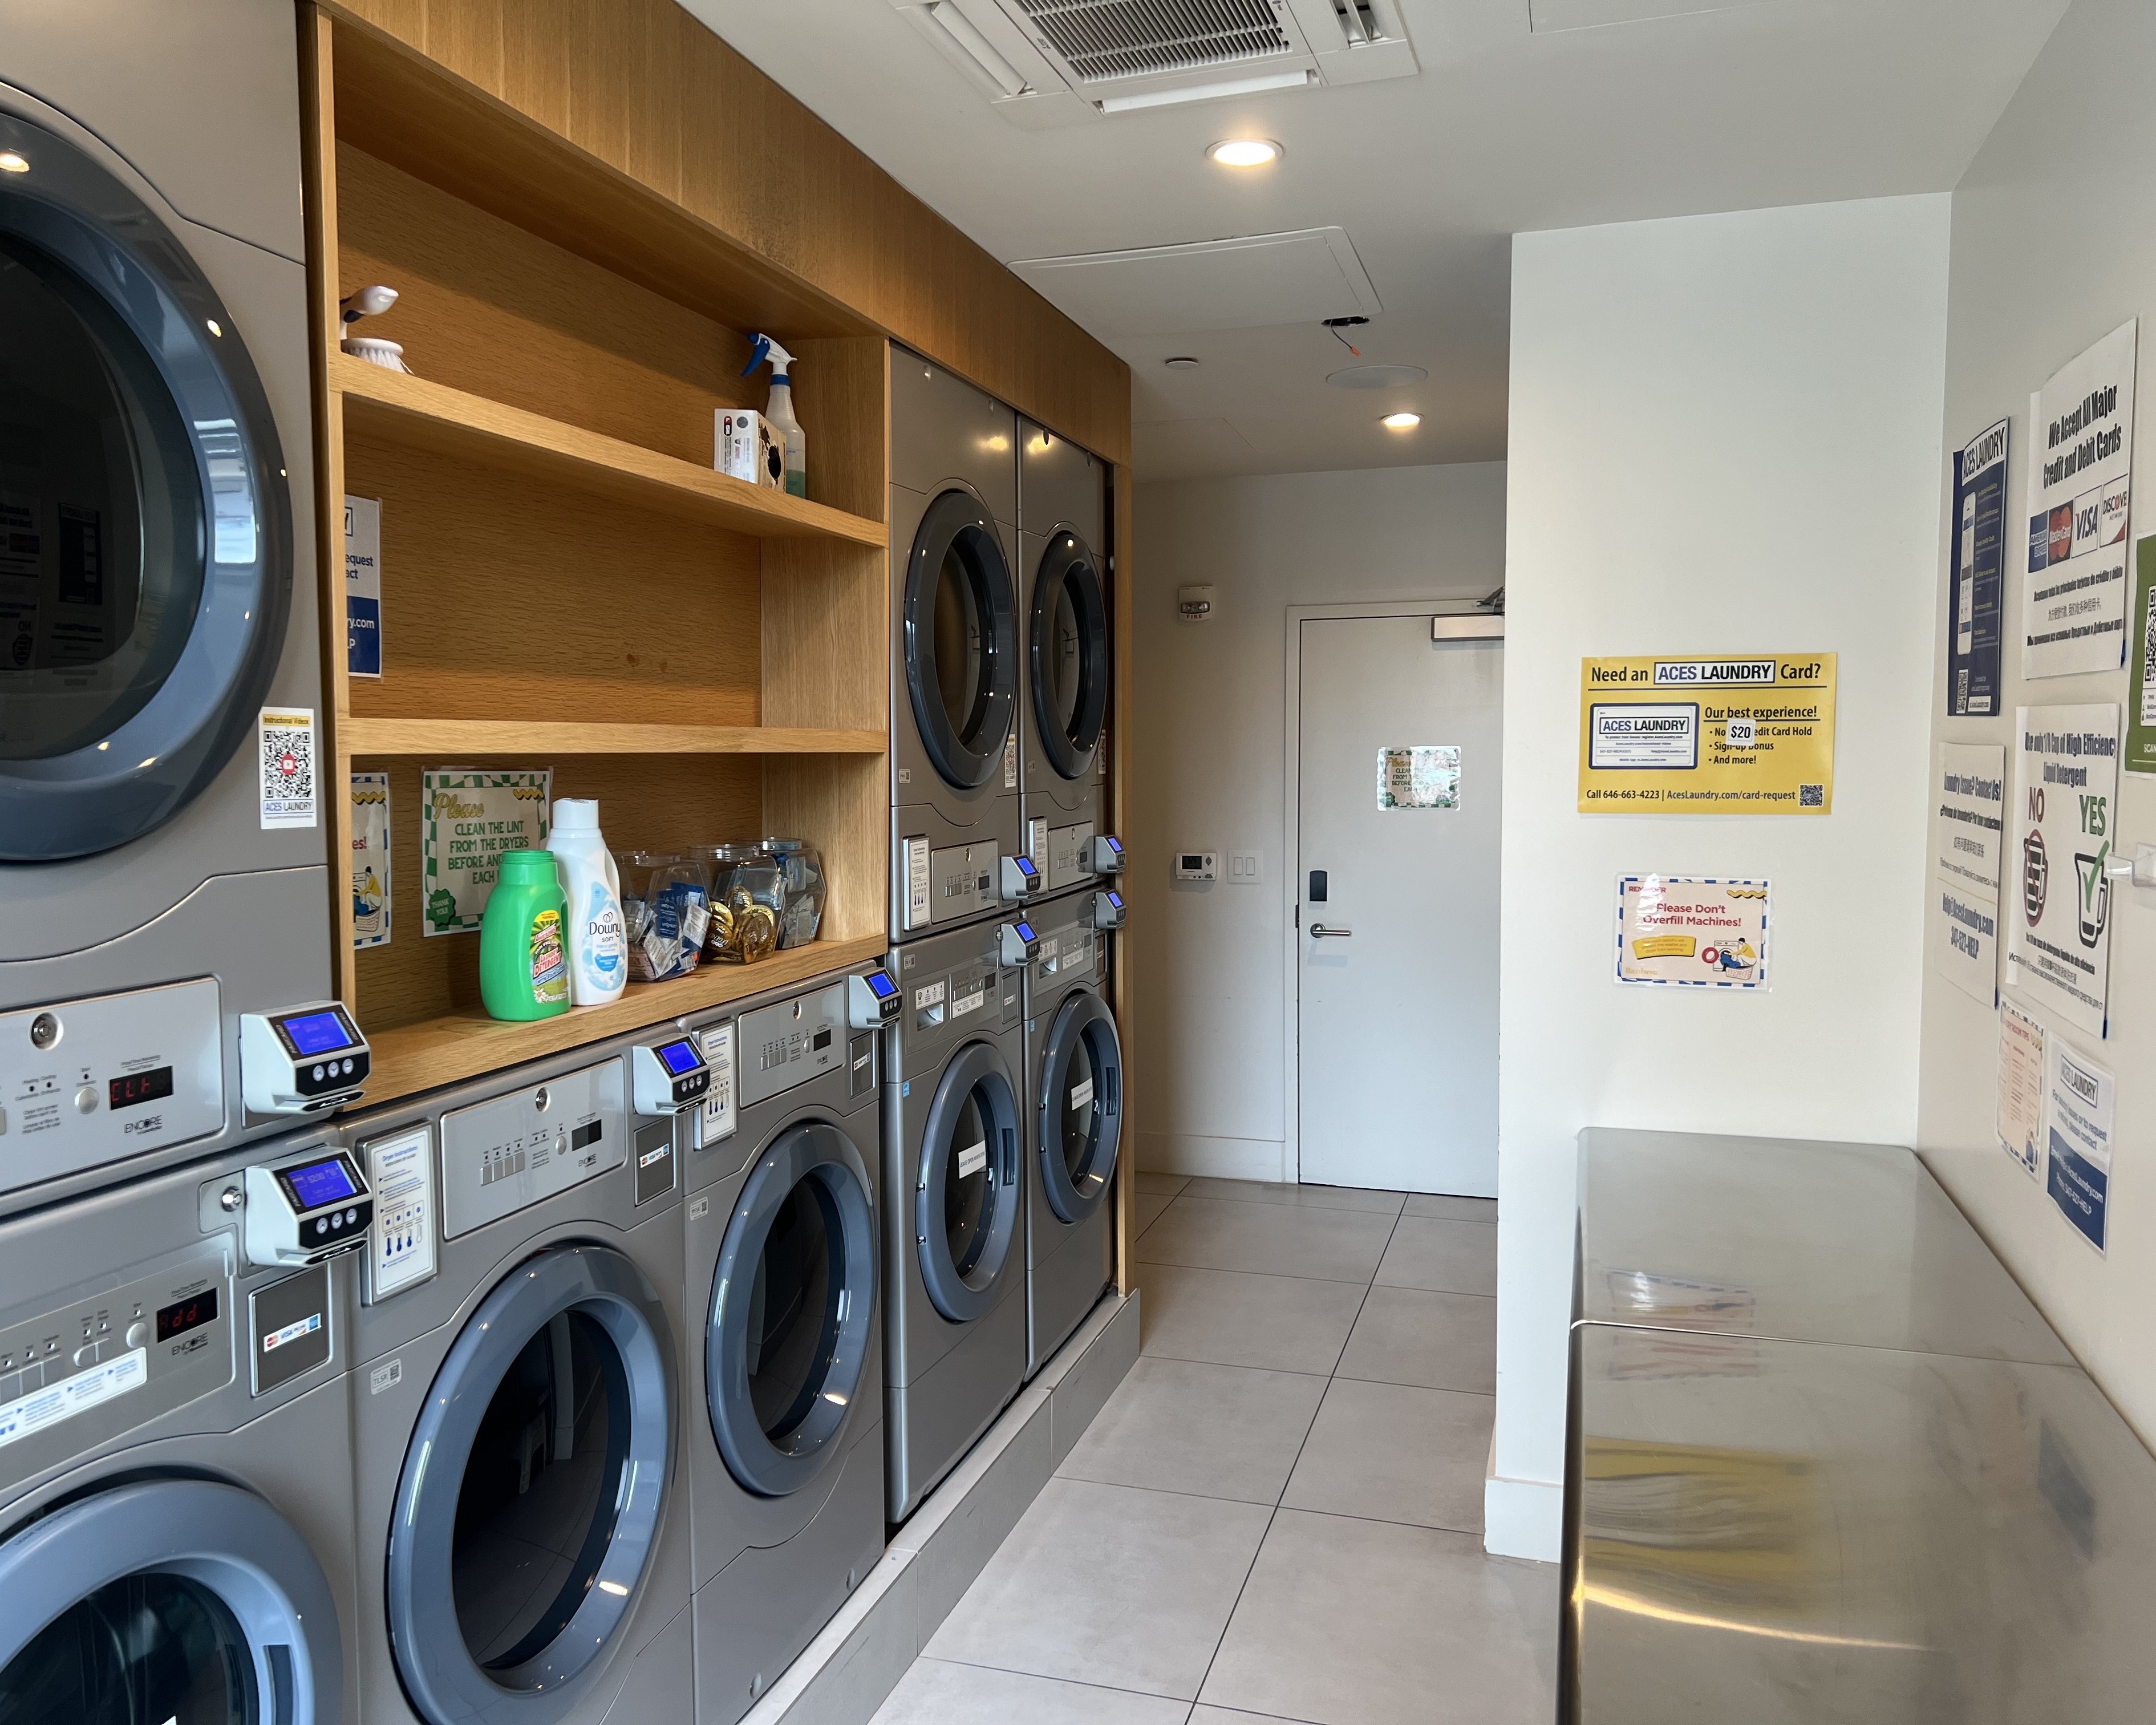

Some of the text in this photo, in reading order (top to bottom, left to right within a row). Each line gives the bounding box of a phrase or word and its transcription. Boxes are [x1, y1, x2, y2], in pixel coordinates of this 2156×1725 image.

[2048, 420, 2060, 450] We
[2061, 404, 2082, 436] Accept
[2092, 384, 2117, 422] Major
[1976, 427, 2005, 471] LAUNDRY
[2044, 423, 2121, 489] Credit and Debit Cards
[2076, 504, 2098, 540] VISA
[345, 553, 374, 566] equest
[1591, 663, 1821, 682] Need an ACES LAUNDRY Card?
[1705, 706, 1817, 720] Our best experience!
[1603, 720, 1686, 731] ACES LAUNDRY
[1715, 728, 1726, 736] No
[1731, 726, 1750, 738] $20
[1772, 727, 1790, 736] Card
[1793, 727, 1812, 735] Hold
[2066, 733, 2082, 757] High
[1713, 755, 1756, 764] And more!
[1587, 789, 1796, 801] Call 646-663-4223 AcesLaundry.com/card-request
[433, 792, 484, 819] Please
[2029, 787, 2044, 823] NO
[2079, 795, 2106, 836] YES
[455, 820, 524, 836] CLEAN THE LINT
[450, 836, 529, 853] FROM THE DRYERS
[448, 856, 484, 870] BEFORE
[473, 872, 495, 884] EACH
[1657, 904, 1726, 913] Please Don't
[1643, 915, 1741, 926] Overfill Machines!
[589, 922, 621, 938] Downy
[535, 951, 561, 976] DETERGENT
[124, 1115, 162, 1133] ENCORE
[171, 1333, 209, 1356] ENCORE
